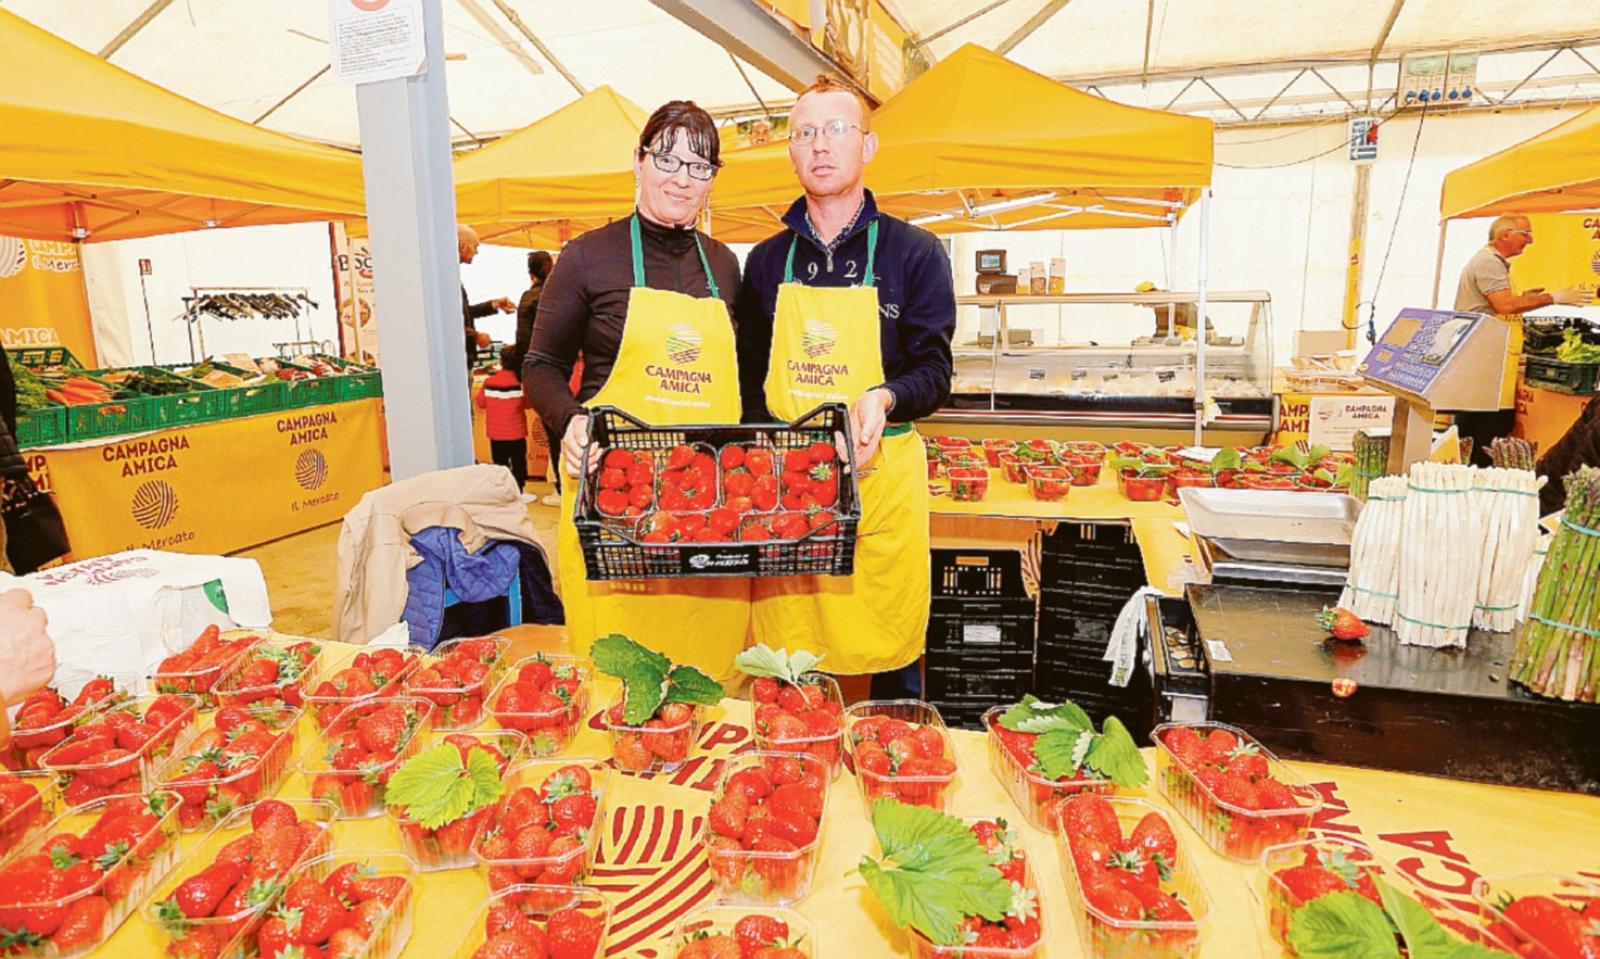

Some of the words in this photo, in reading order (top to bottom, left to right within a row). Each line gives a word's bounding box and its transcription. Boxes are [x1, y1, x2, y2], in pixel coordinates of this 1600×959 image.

[808, 262, 818, 280] 9
[844, 260, 858, 278] 2
[645, 365, 712, 384] CAMPAGNA
[787, 360, 849, 376] CAMPAGNA
[660, 379, 701, 394] AMICA
[795, 374, 836, 386] AMICA
[277, 411, 338, 432] CAMPAGNA
[290, 427, 328, 446] AMICA
[102, 435, 190, 462] CAMPAGNA
[121, 454, 178, 477] AMICA
[142, 531, 195, 550] Mercato
